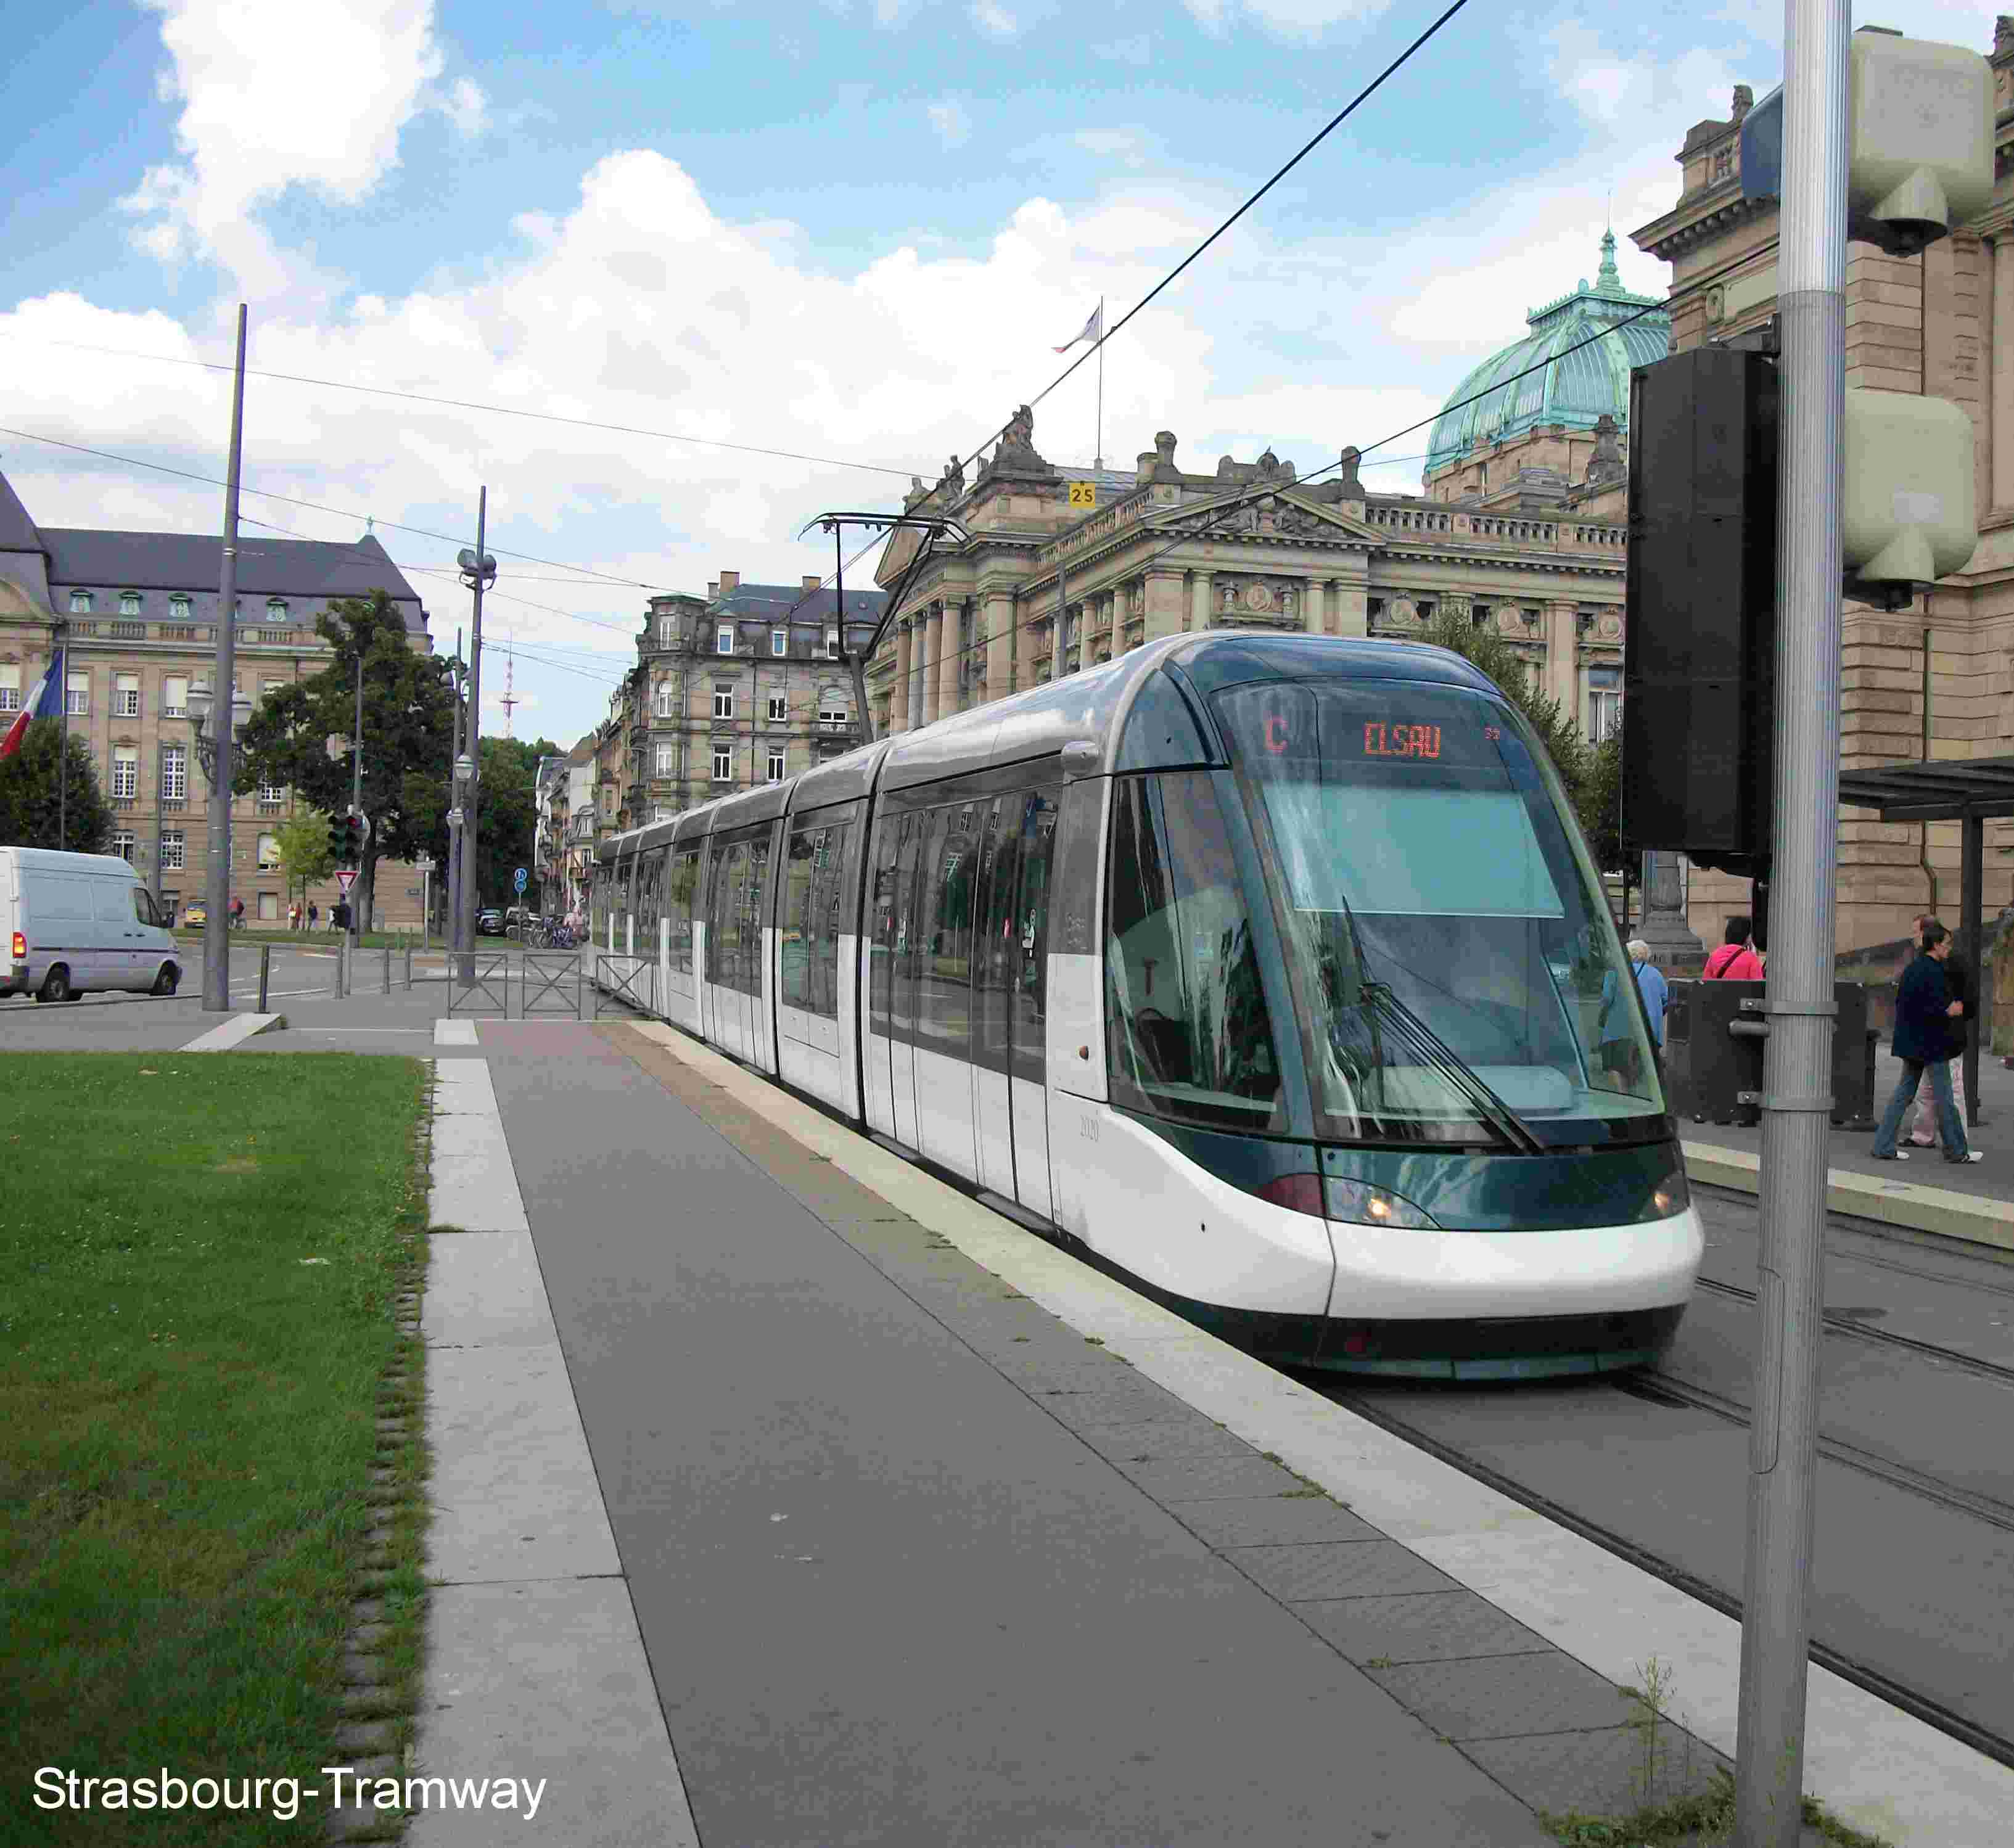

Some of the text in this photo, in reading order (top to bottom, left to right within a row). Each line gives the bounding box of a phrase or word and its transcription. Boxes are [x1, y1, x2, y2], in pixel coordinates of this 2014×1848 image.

[1072, 489, 1093, 503] 25
[1263, 714, 1288, 755] C
[1364, 723, 1441, 758] ELSAU
